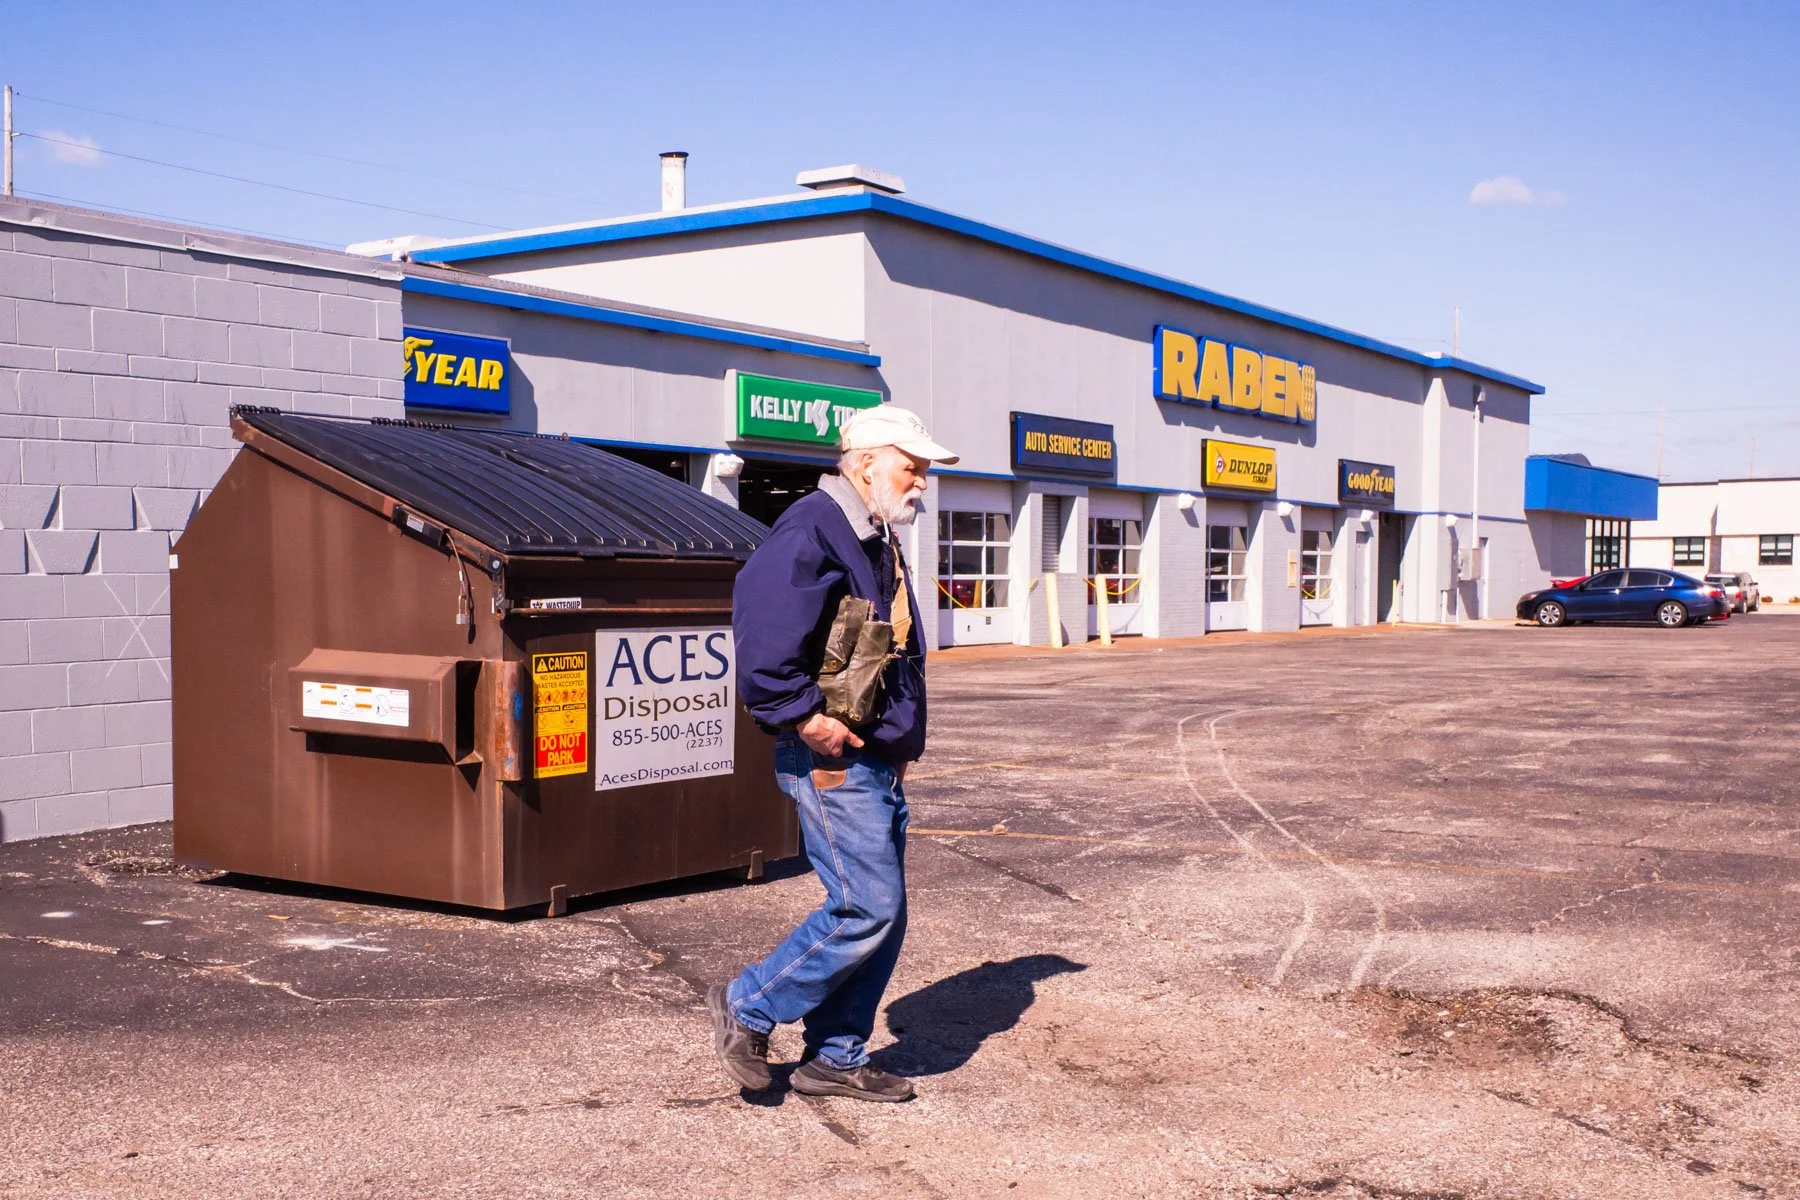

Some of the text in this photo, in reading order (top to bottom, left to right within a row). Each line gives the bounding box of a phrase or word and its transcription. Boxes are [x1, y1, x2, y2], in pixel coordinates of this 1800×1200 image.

[1161, 328, 1316, 421] RABEN
[750, 394, 802, 423] KELLY
[1025, 431, 1112, 459] AUTO SERVICE CENTER
[1229, 459, 1273, 476] DUNLOP
[1347, 470, 1394, 494] GOODYEAR
[548, 655, 584, 671] CAUTION
[606, 632, 729, 687] ACES
[549, 672, 581, 680] HAZARDOUS
[604, 686, 728, 721] Disposal
[540, 733, 581, 751] DO NOT
[612, 719, 723, 746] 855-500-ACES
[686, 736, 723, 751] (2237)
[547, 750, 574, 766] PARK
[600, 759, 734, 786] AcesDisposal.com
